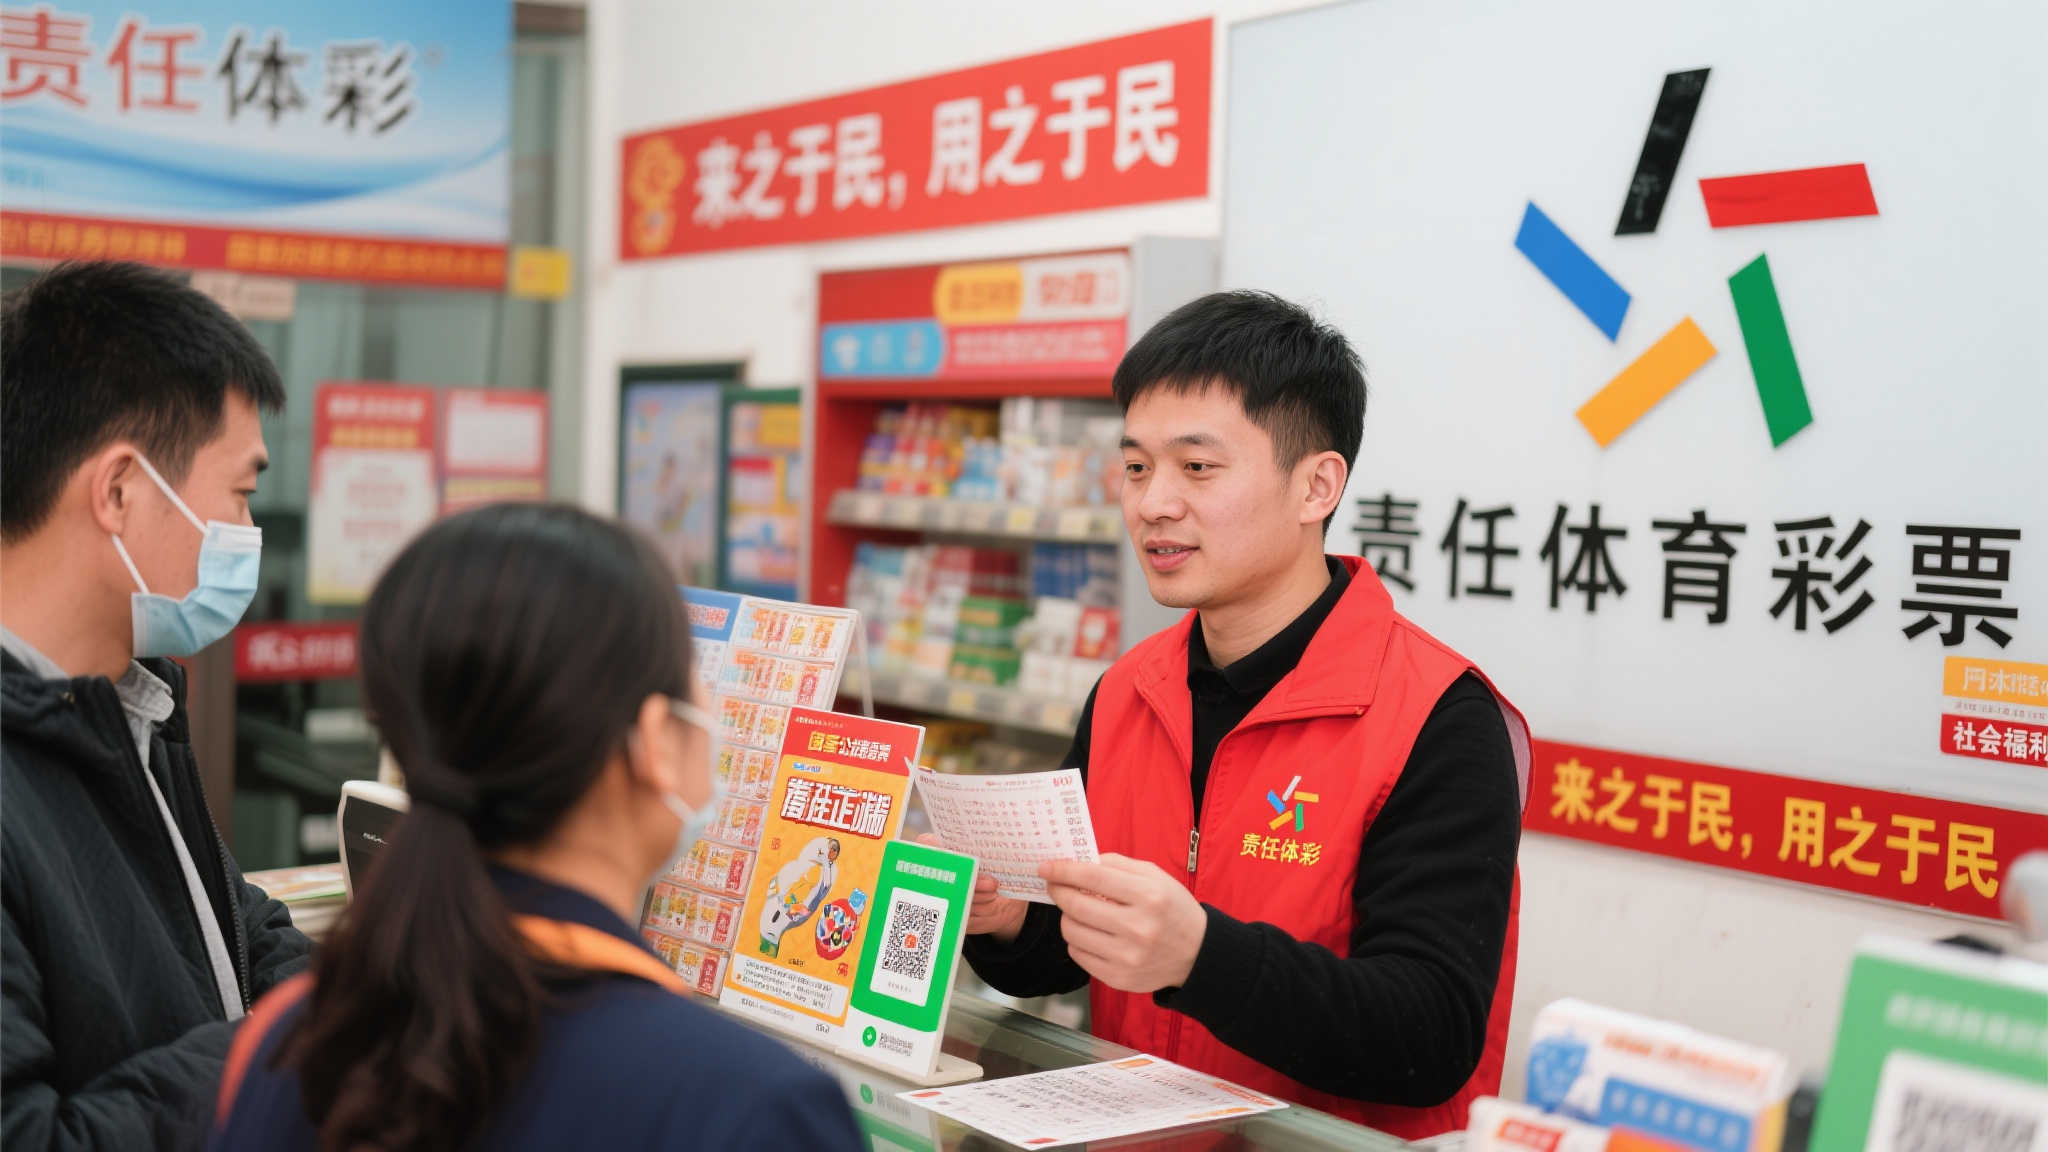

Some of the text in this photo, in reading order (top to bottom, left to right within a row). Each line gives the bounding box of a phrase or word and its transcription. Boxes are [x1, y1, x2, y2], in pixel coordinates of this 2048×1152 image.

[0, 12, 415, 132] 责任体彩
[1351, 493, 2021, 649] 责任体育彩票
[1239, 832, 1322, 866] 责任体彩
